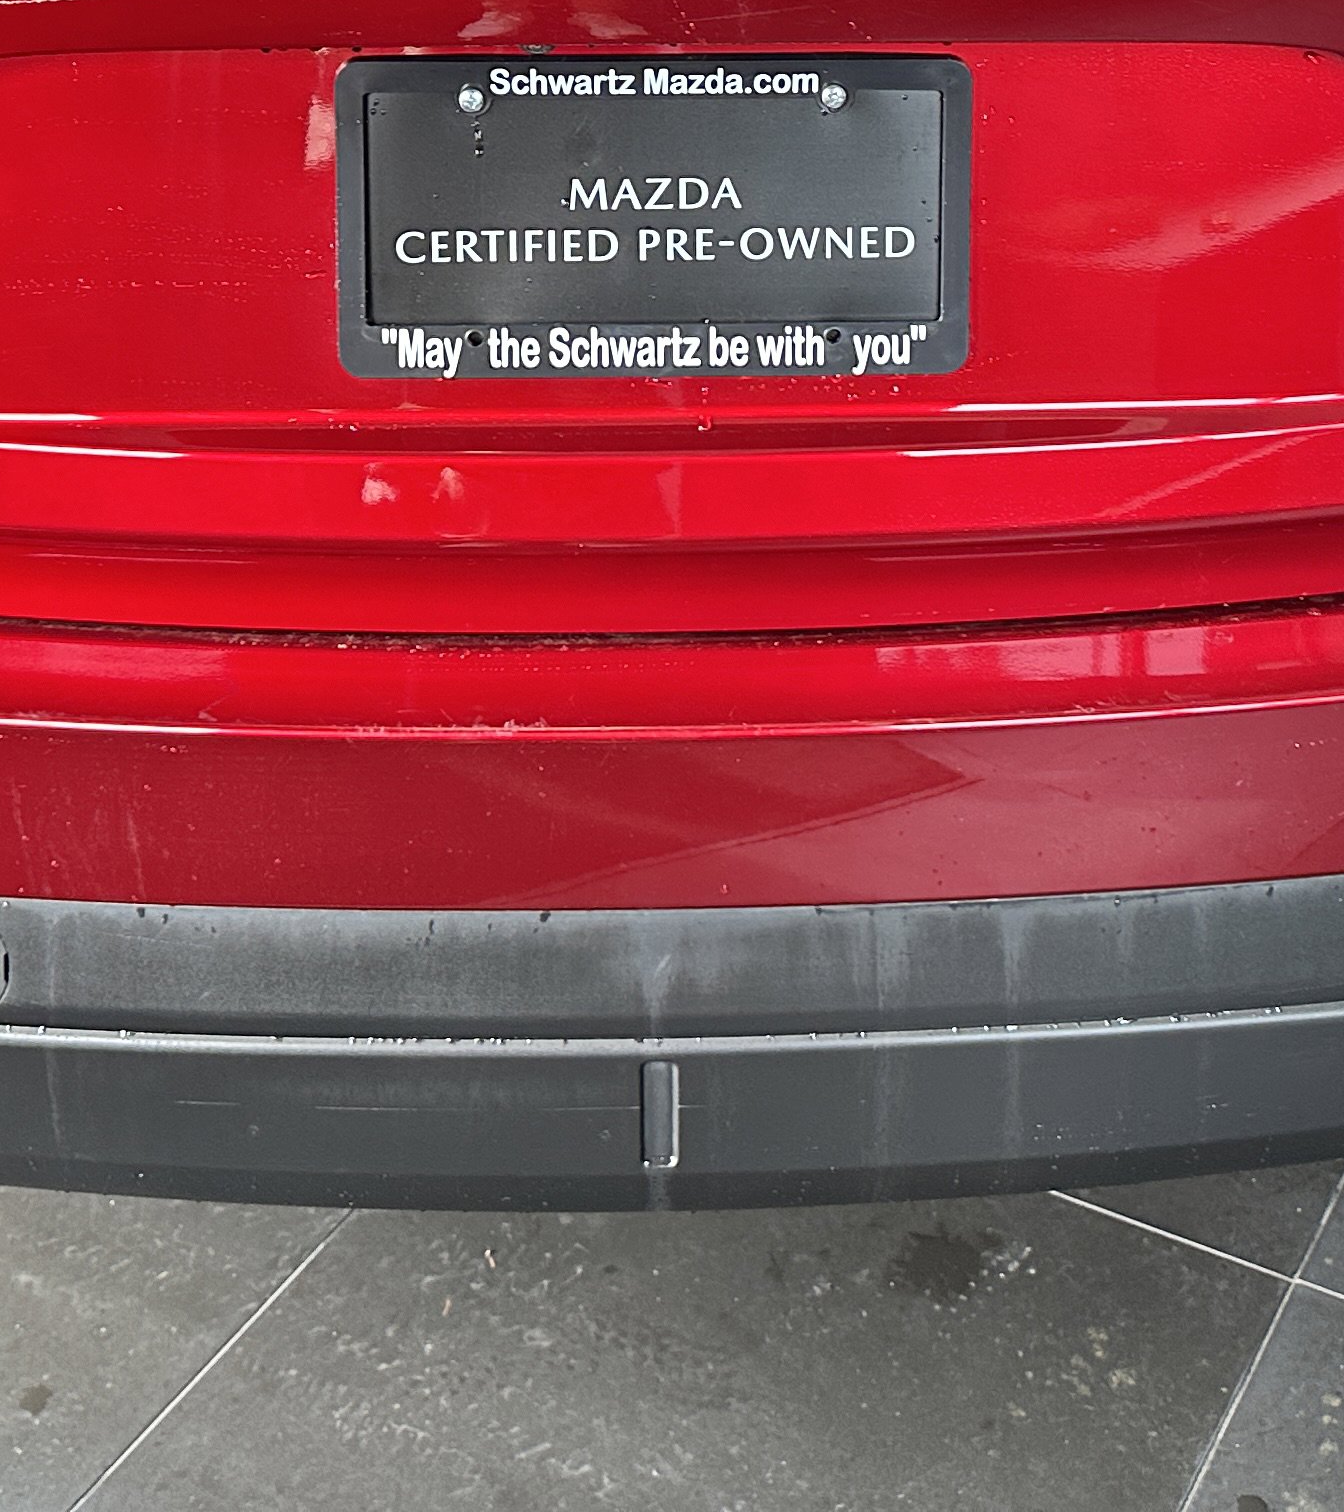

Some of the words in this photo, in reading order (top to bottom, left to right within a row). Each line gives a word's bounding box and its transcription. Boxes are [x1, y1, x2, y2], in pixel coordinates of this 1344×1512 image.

[489, 67, 636, 96] Schwartz
[643, 67, 820, 95] Mazda.com
[568, 176, 743, 211] MAZDA
[395, 228, 620, 265] CERTIFIED
[638, 225, 917, 263] PRE-OWNED
[487, 327, 541, 369] the
[548, 326, 703, 370] Schwartz
[708, 326, 749, 369] be
[755, 324, 825, 367] with
